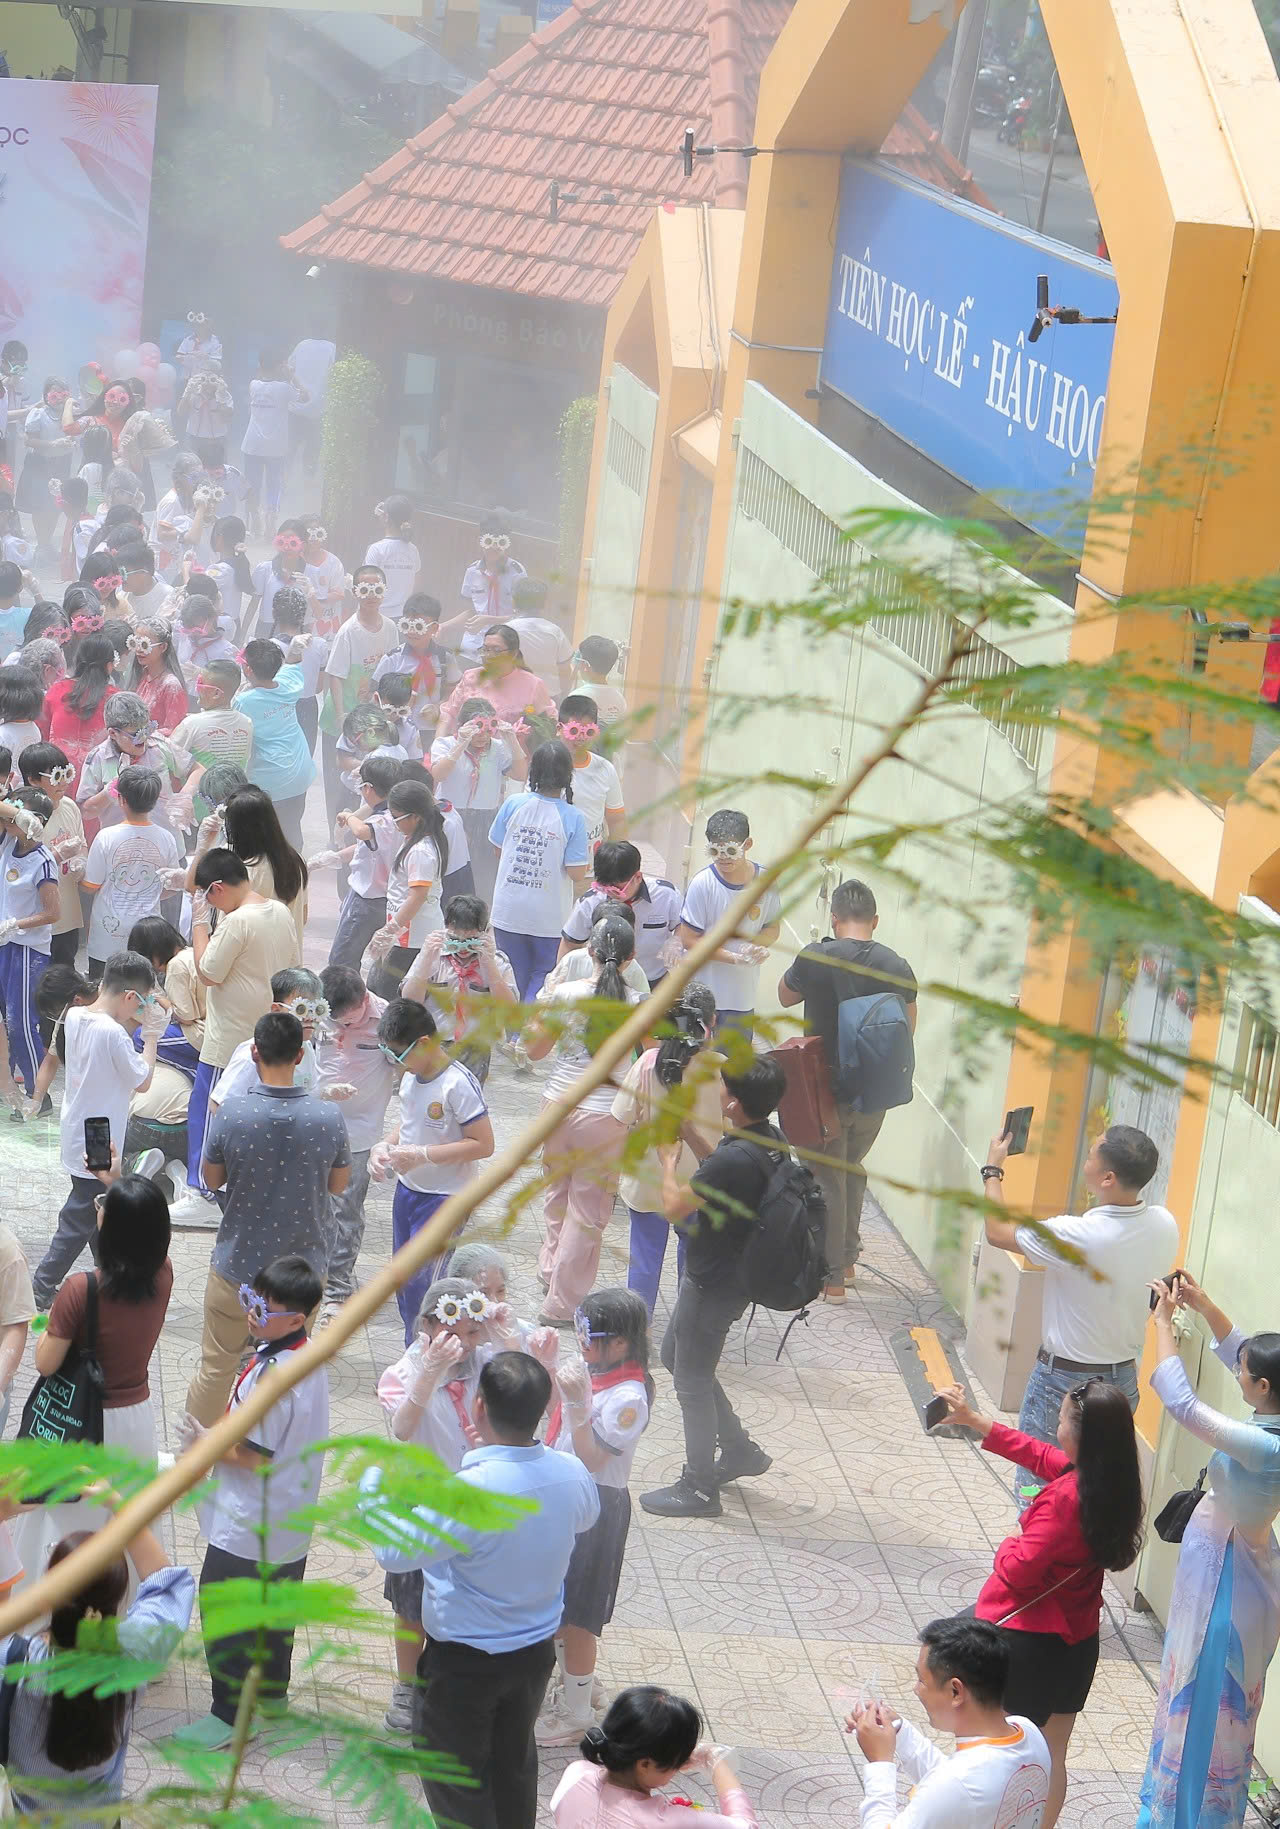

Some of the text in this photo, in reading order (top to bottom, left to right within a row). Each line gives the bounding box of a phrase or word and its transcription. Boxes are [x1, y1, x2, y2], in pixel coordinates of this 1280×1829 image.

[837, 247, 887, 335] TIÊN
[886, 281, 935, 372] HỌC
[934, 296, 974, 388] LỄ
[985, 330, 1047, 437] HẬU
[1046, 371, 1106, 477] HỌC
